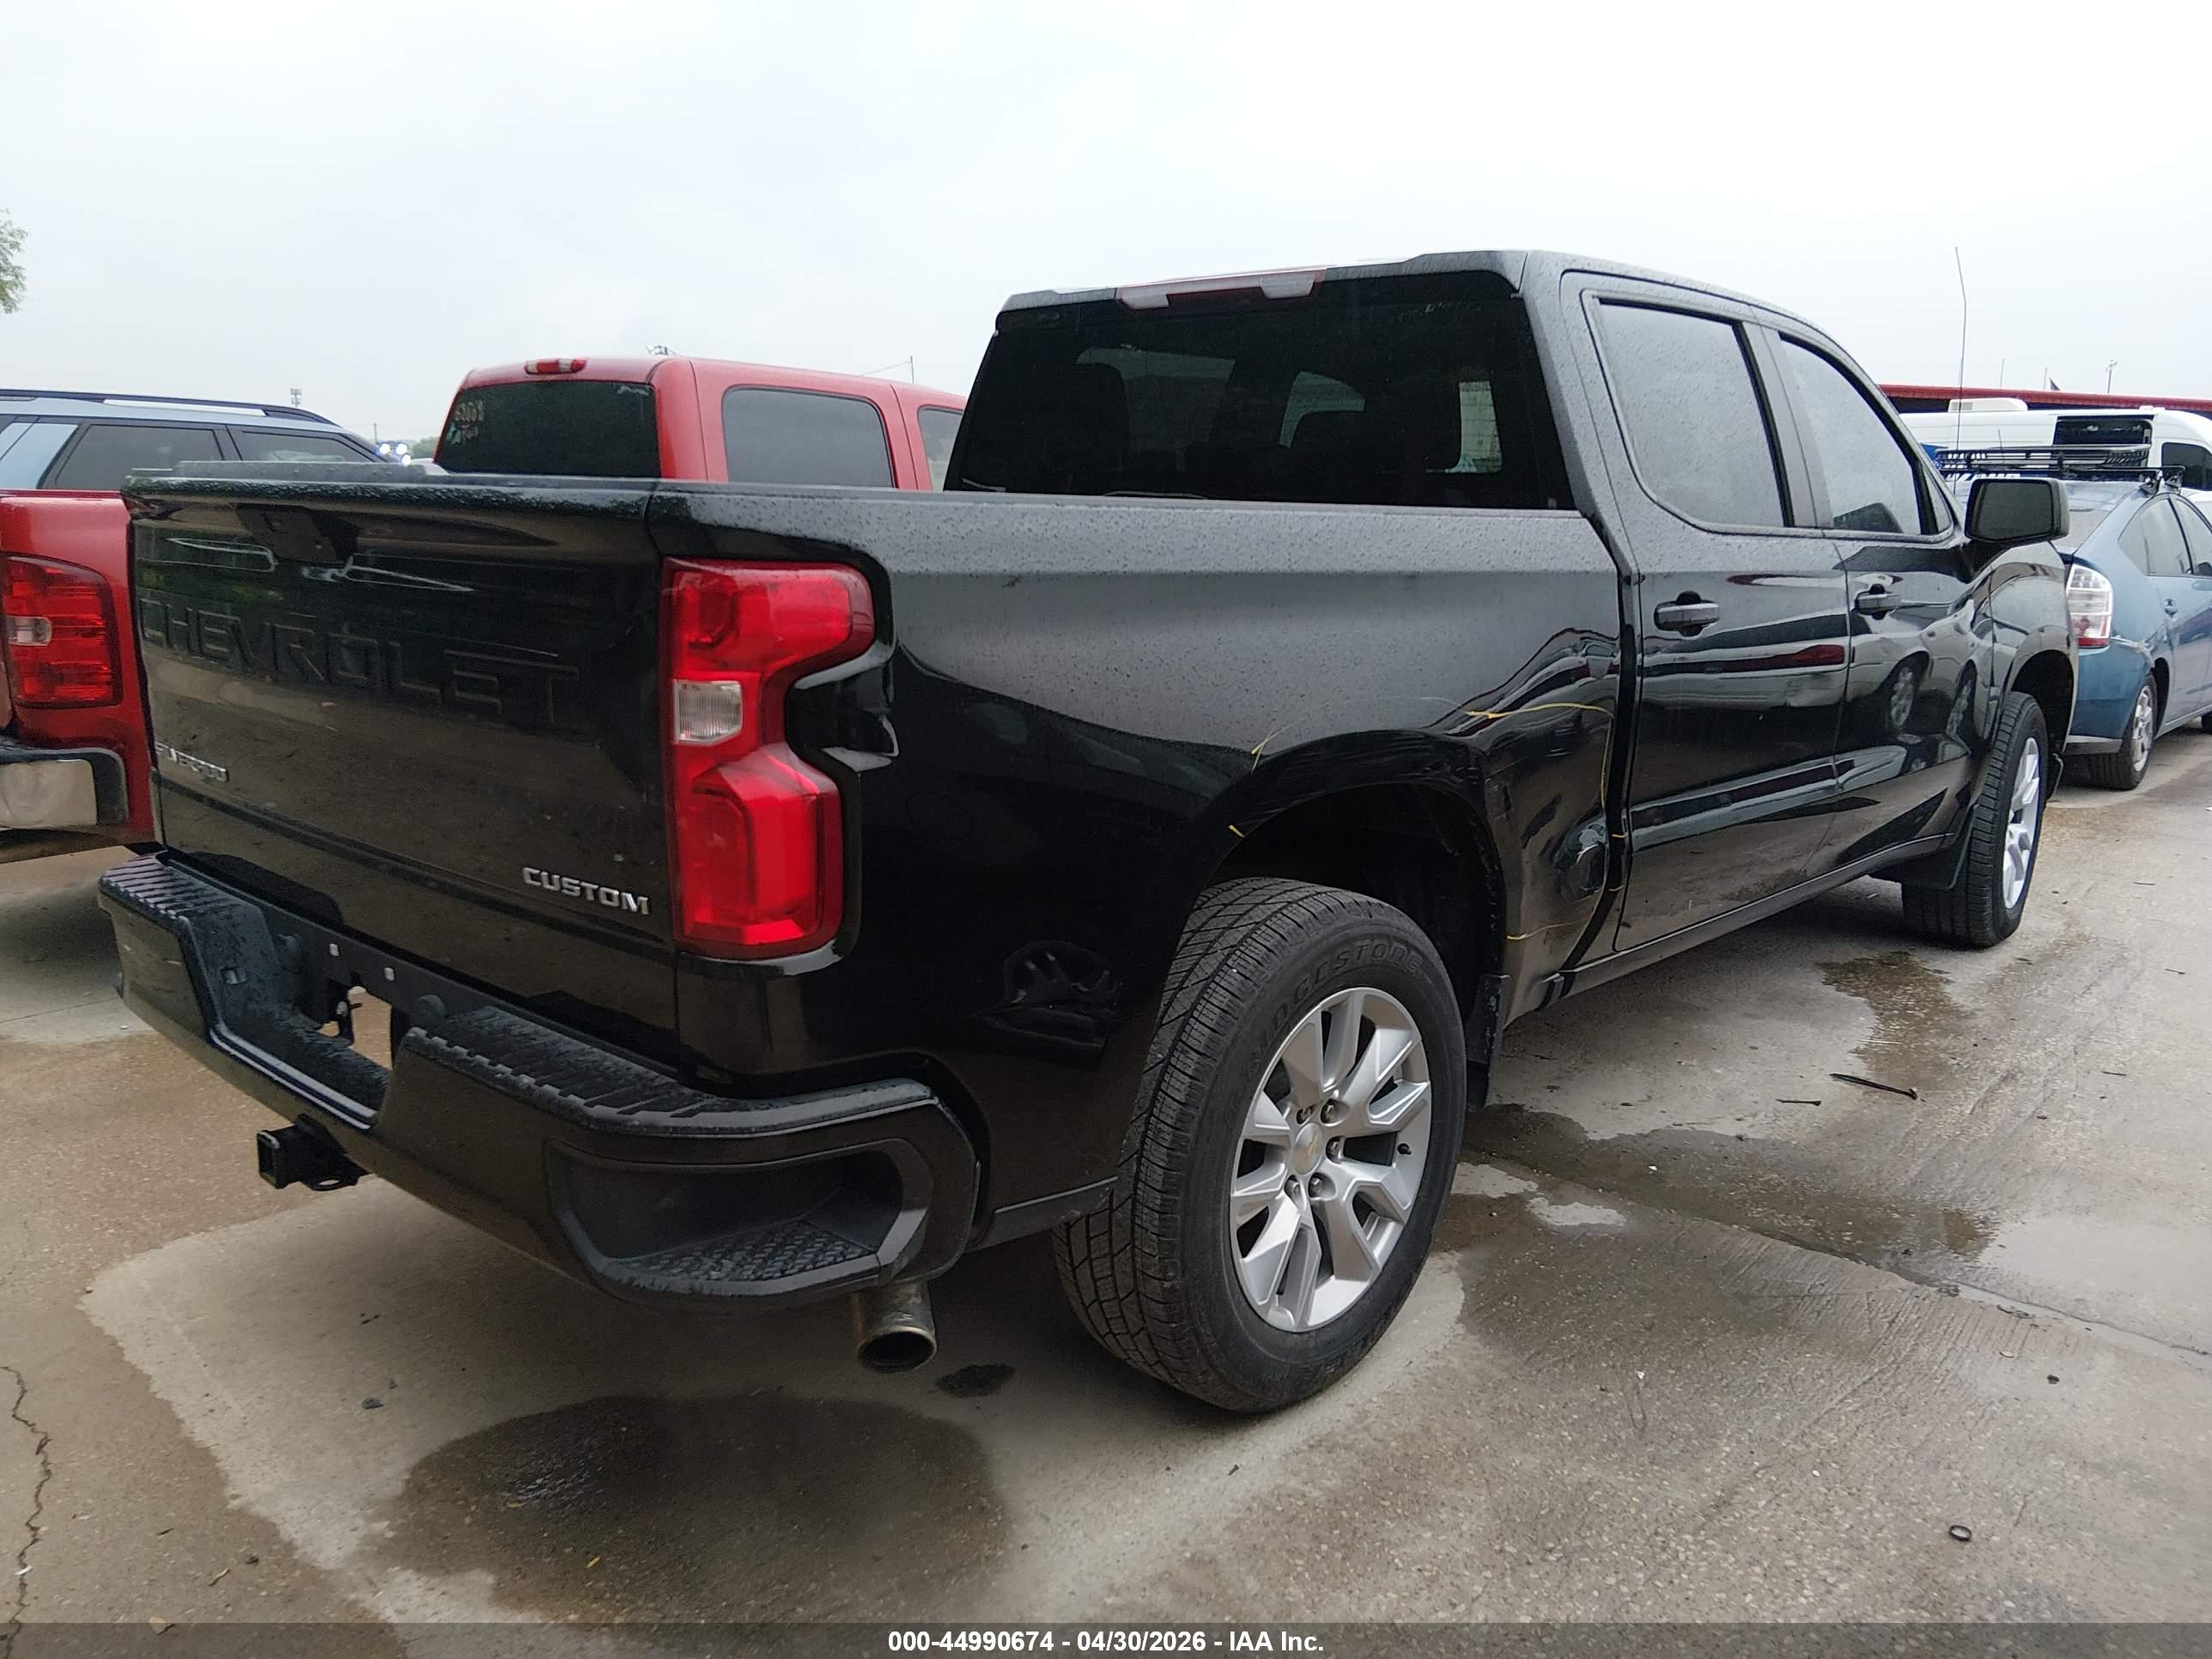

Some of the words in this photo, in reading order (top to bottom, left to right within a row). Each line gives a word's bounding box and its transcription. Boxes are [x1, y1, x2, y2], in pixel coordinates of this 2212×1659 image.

[138, 597, 582, 728] CHEVROLET
[521, 866, 650, 915] CUSTOM
[1249, 940, 1424, 1075] IDGESTONE
